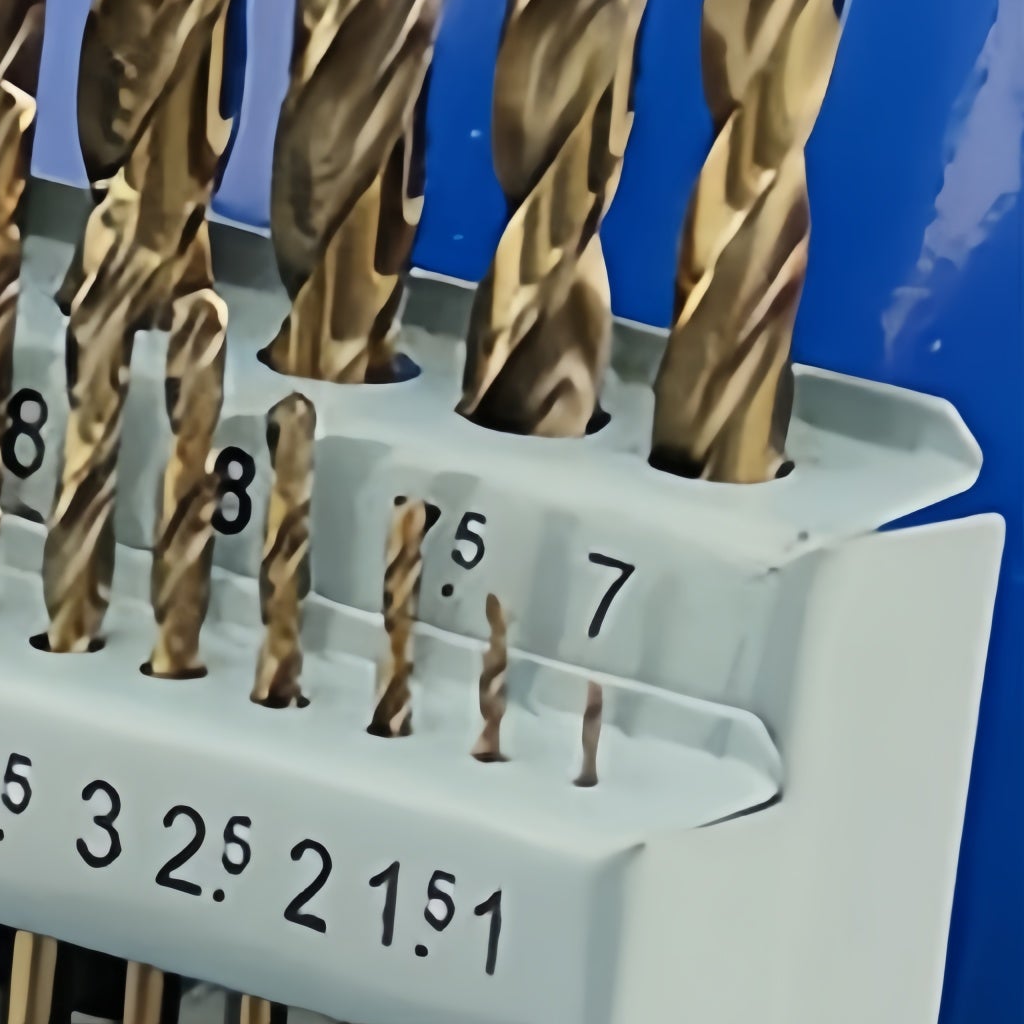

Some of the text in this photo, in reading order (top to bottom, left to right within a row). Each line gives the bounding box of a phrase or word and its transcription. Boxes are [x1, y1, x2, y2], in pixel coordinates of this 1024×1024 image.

[212, 445, 257, 536] 8
[588, 552, 636, 639] 7
[75, 779, 122, 869] 3
[154, 804, 252, 903] 2.5
[283, 838, 333, 934] 2
[473, 888, 502, 976] 1
